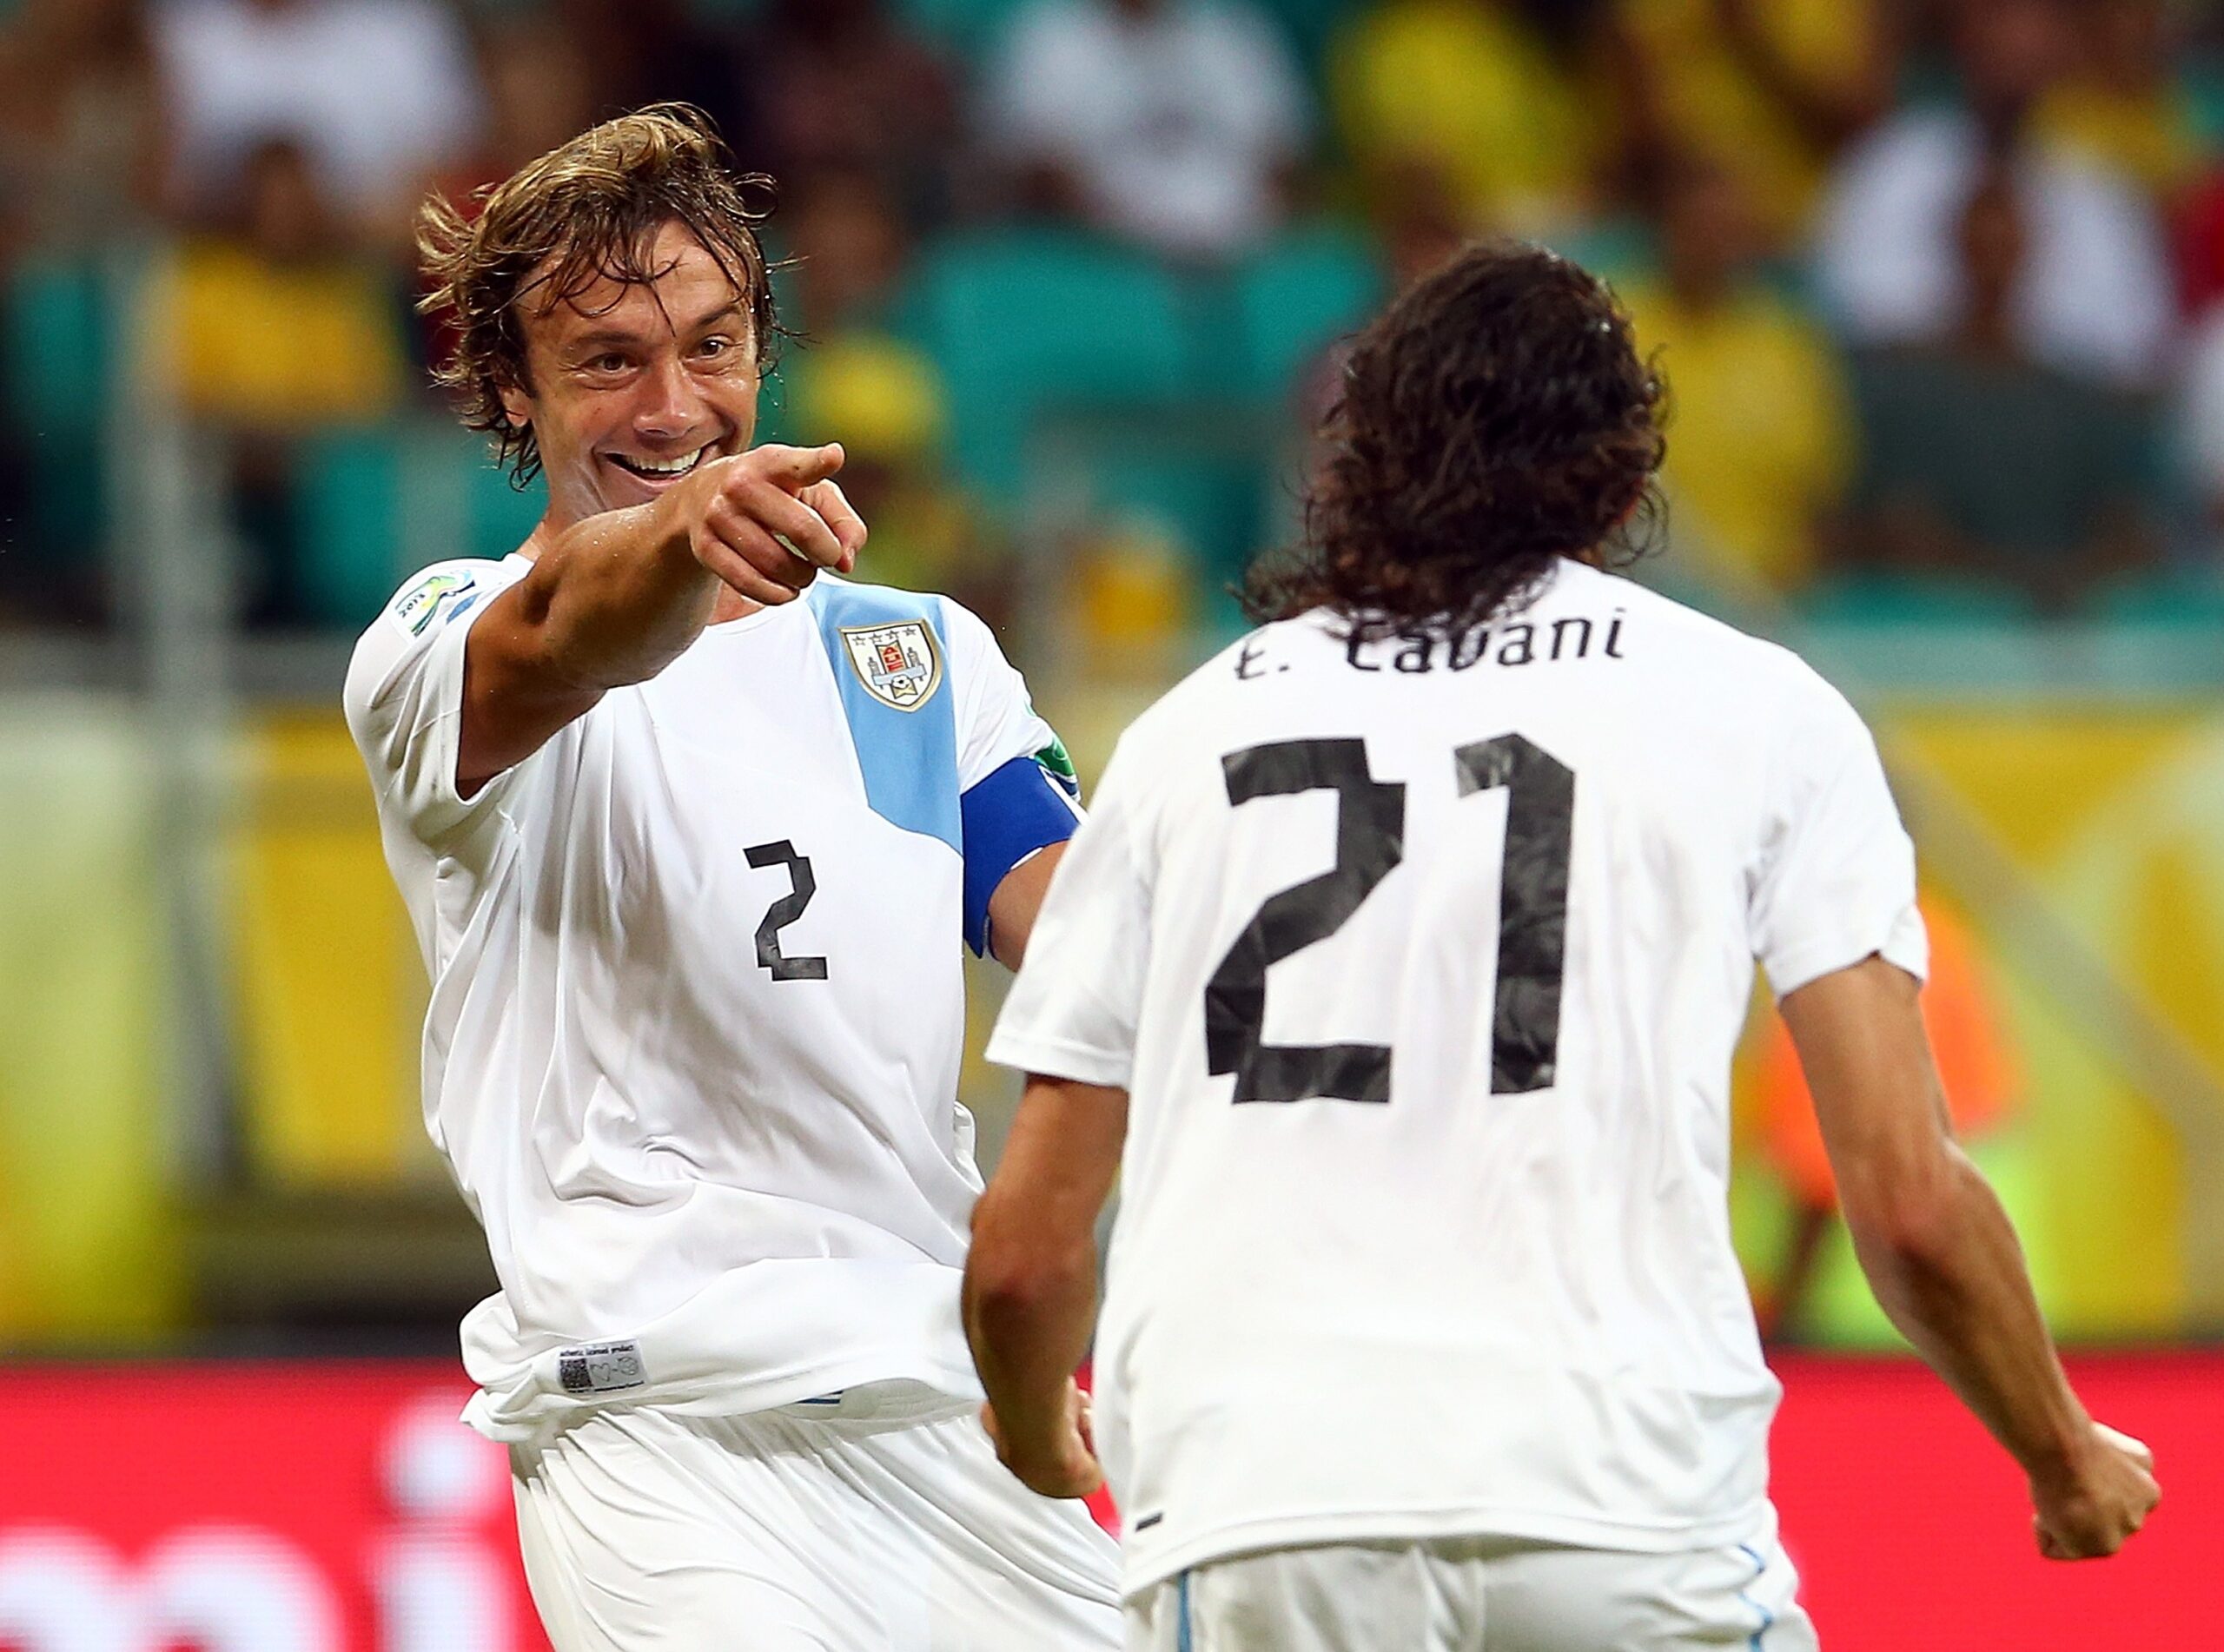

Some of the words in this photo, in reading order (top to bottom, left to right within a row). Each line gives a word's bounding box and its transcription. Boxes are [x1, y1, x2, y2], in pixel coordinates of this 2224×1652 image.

[1346, 607, 1626, 673] Cavani
[743, 839, 828, 981] 2
[1205, 732, 1576, 1105] 21
